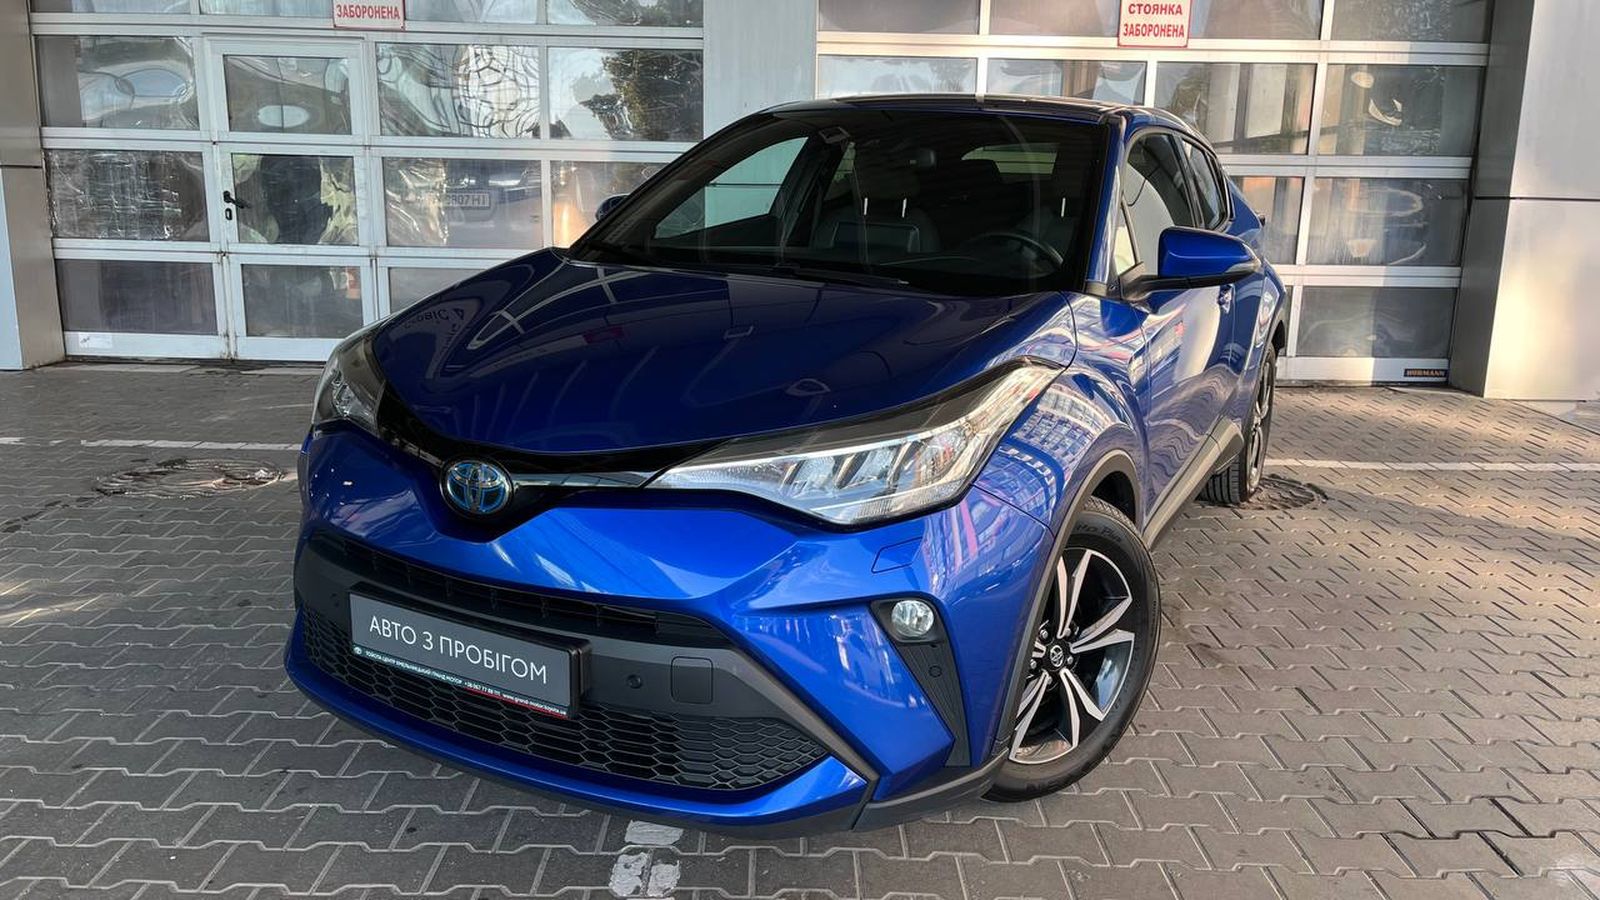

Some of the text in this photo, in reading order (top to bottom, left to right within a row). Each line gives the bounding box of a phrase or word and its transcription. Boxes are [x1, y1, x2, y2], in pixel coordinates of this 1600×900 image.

[336, 4, 400, 19] ЗАБОРОНЕНА
[1128, 3, 1183, 15] СТОЯНКА
[1123, 23, 1184, 38] ЗАБОРОНЕНА
[369, 615, 417, 645] АВТО
[440, 635, 547, 685] ПРОБІГОМ
